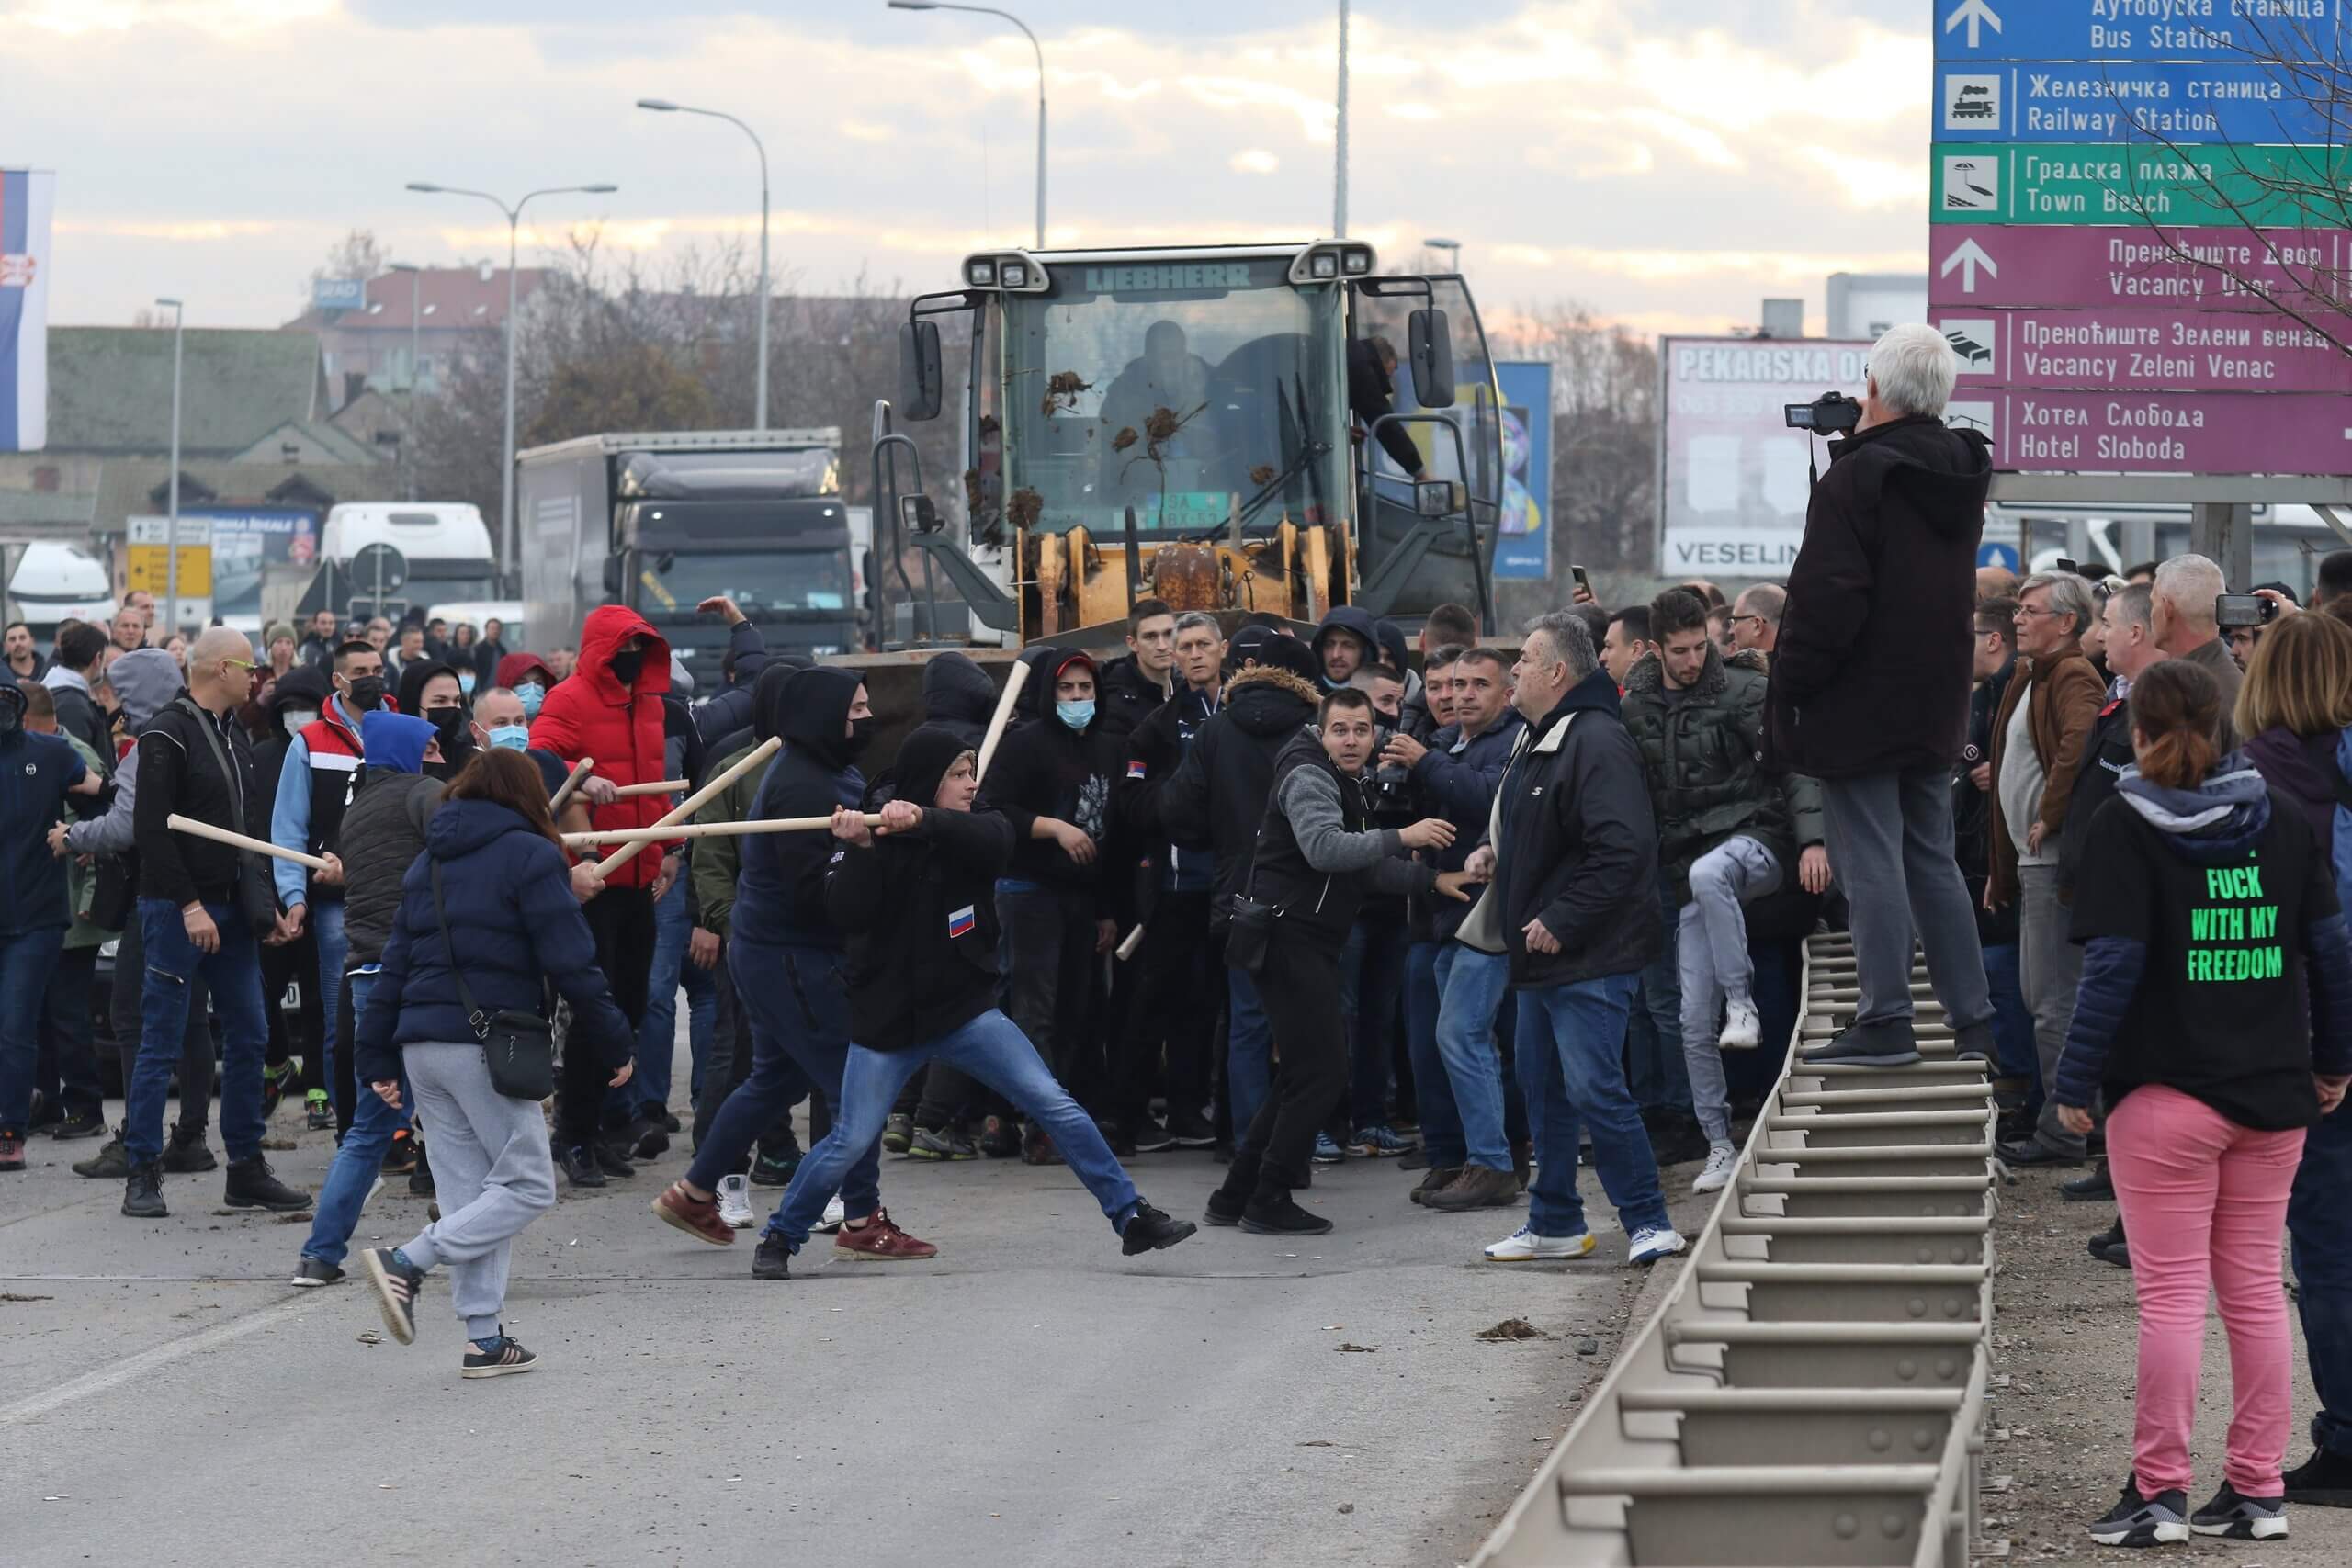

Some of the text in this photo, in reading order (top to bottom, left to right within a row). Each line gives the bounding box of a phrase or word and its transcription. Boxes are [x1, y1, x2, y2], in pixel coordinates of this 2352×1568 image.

[2231, 0, 2324, 19] станица
[2090, 25, 2232, 49] Bus Station
[2030, 74, 2282, 101] Железничка станица
[2028, 107, 2218, 137] Railway Station
[2026, 156, 2212, 185] Градска плажа
[2026, 189, 2170, 213] Town Beach
[2109, 239, 2323, 268] Преноћиште Двор
[1086, 264, 1251, 292] LIEBHERR
[2109, 272, 2275, 302] Vacancy Dvor
[2023, 321, 2330, 349] Преноћиште Зелени венац
[1678, 348, 1833, 383] PEKARSKA
[2023, 353, 2276, 382] Vacancy Zeleni Venac
[2022, 402, 2205, 429] Хотел Слобода
[2021, 434, 2186, 460] Hotel Sloboda
[2206, 866, 2264, 900] FUCK
[2191, 906, 2278, 942] WITH MY
[2188, 946, 2283, 981] FREEDOM
